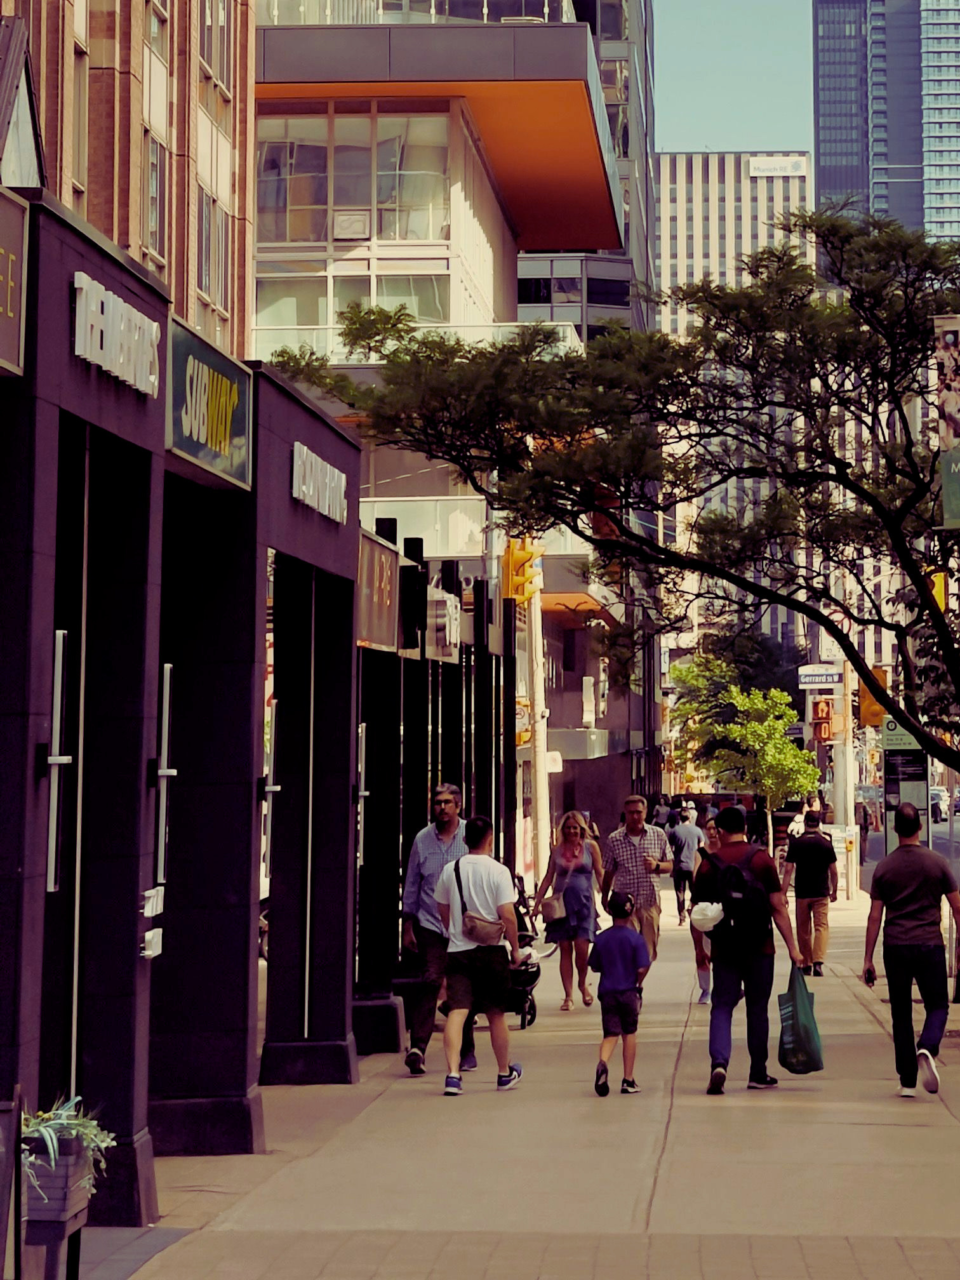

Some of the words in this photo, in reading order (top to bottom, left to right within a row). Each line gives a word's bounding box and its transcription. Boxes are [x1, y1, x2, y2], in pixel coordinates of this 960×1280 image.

[181, 354, 239, 458] SUBWAY
[800, 675, 826, 683] Gerrard
[833, 674, 839, 682] W
